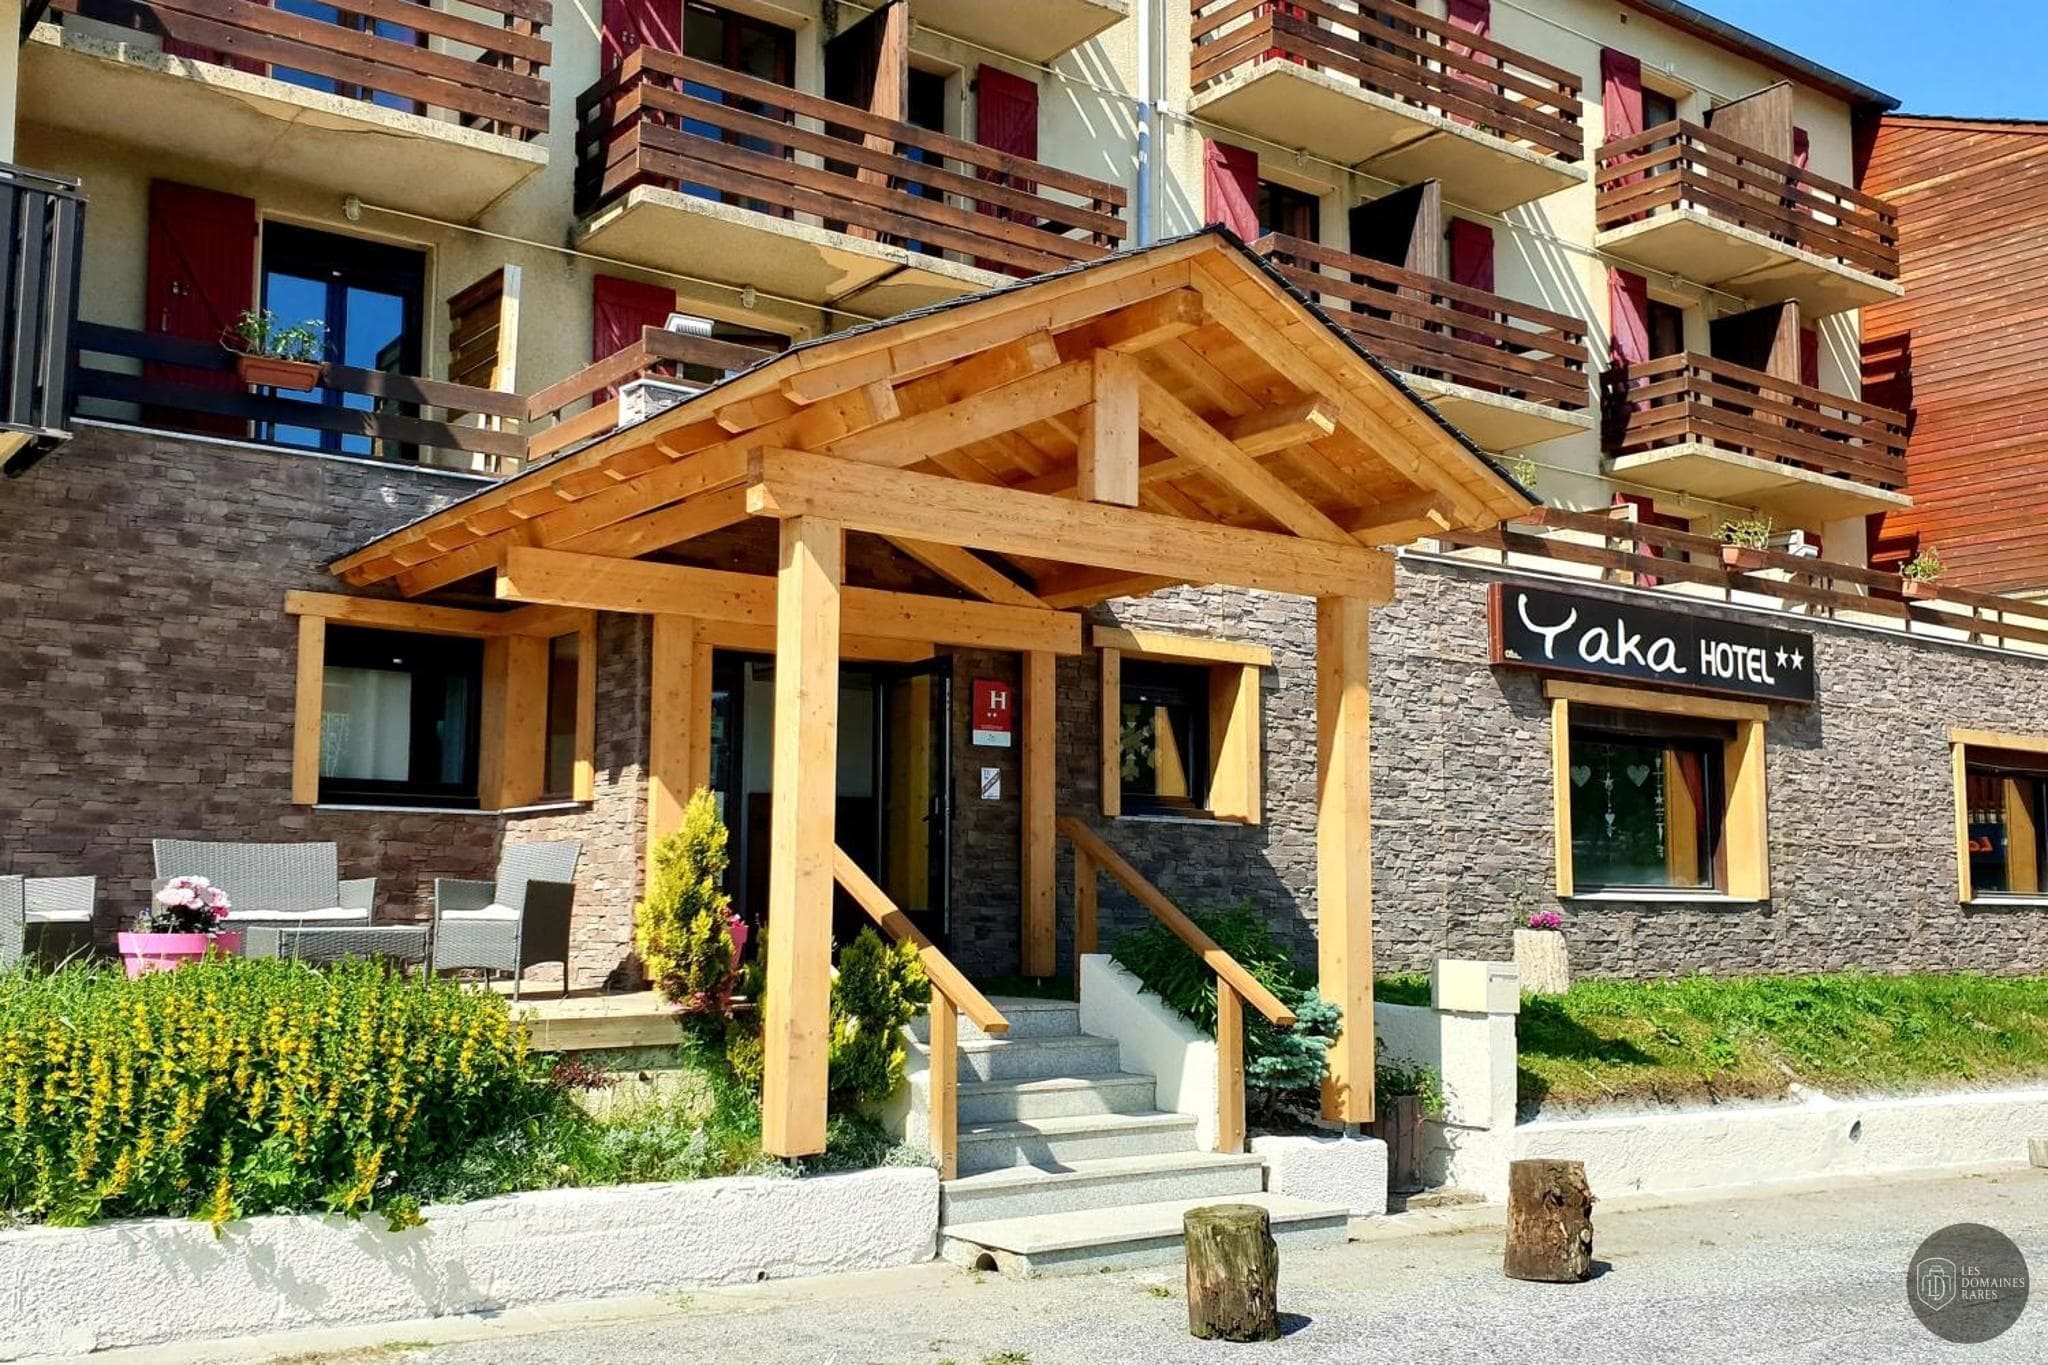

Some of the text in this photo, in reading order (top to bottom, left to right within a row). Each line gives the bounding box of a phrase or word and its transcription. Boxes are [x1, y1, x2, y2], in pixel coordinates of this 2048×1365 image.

[1518, 593, 1775, 684] Yaka HOTEL
[990, 690, 1007, 710] H
